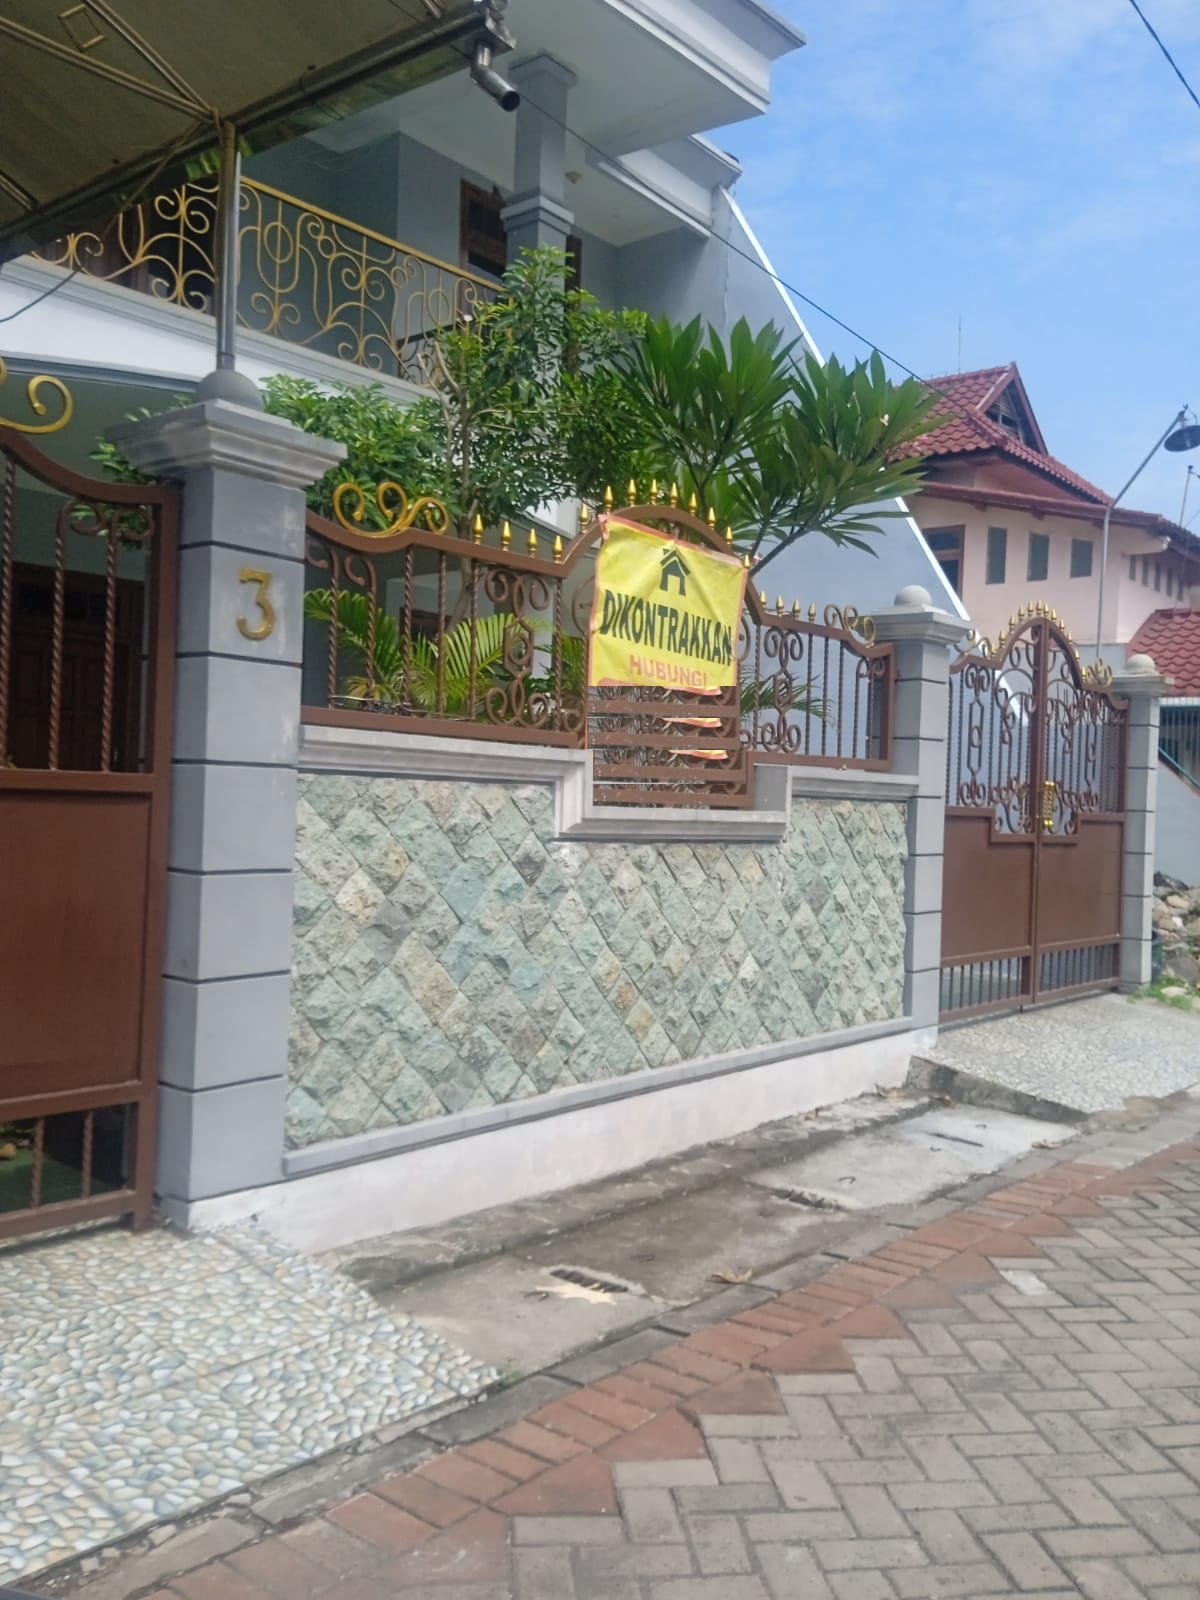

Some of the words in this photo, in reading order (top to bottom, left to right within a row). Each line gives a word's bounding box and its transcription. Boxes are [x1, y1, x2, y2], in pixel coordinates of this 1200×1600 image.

[236, 567, 276, 641] 3
[599, 589, 732, 667] DIKONTRAKKAN
[629, 654, 708, 686] HUBUNGI
